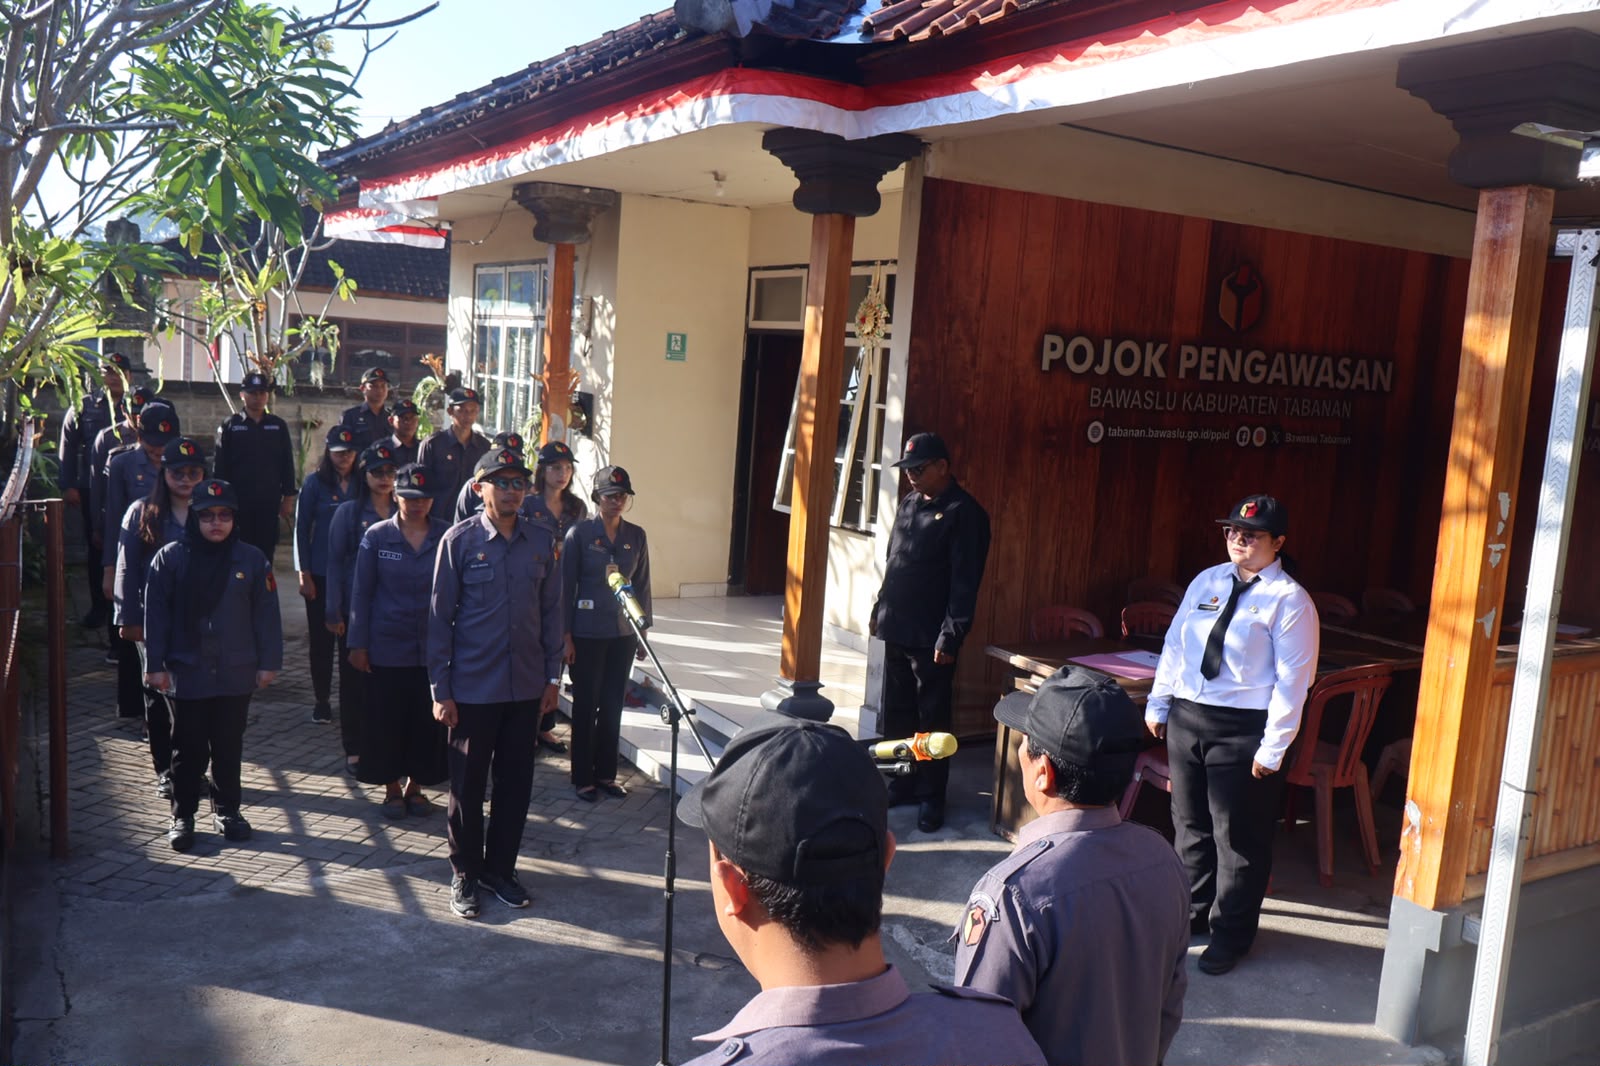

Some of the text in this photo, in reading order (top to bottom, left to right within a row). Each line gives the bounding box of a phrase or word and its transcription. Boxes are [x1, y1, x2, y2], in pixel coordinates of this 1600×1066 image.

[1041, 333, 1393, 392] POJOK PENGAWASAN
[1089, 387, 1352, 418] BAWASLU KABUPATEN TABANAN
[1107, 426, 1231, 442] tabanan.bawaslu.go.id/ppid
